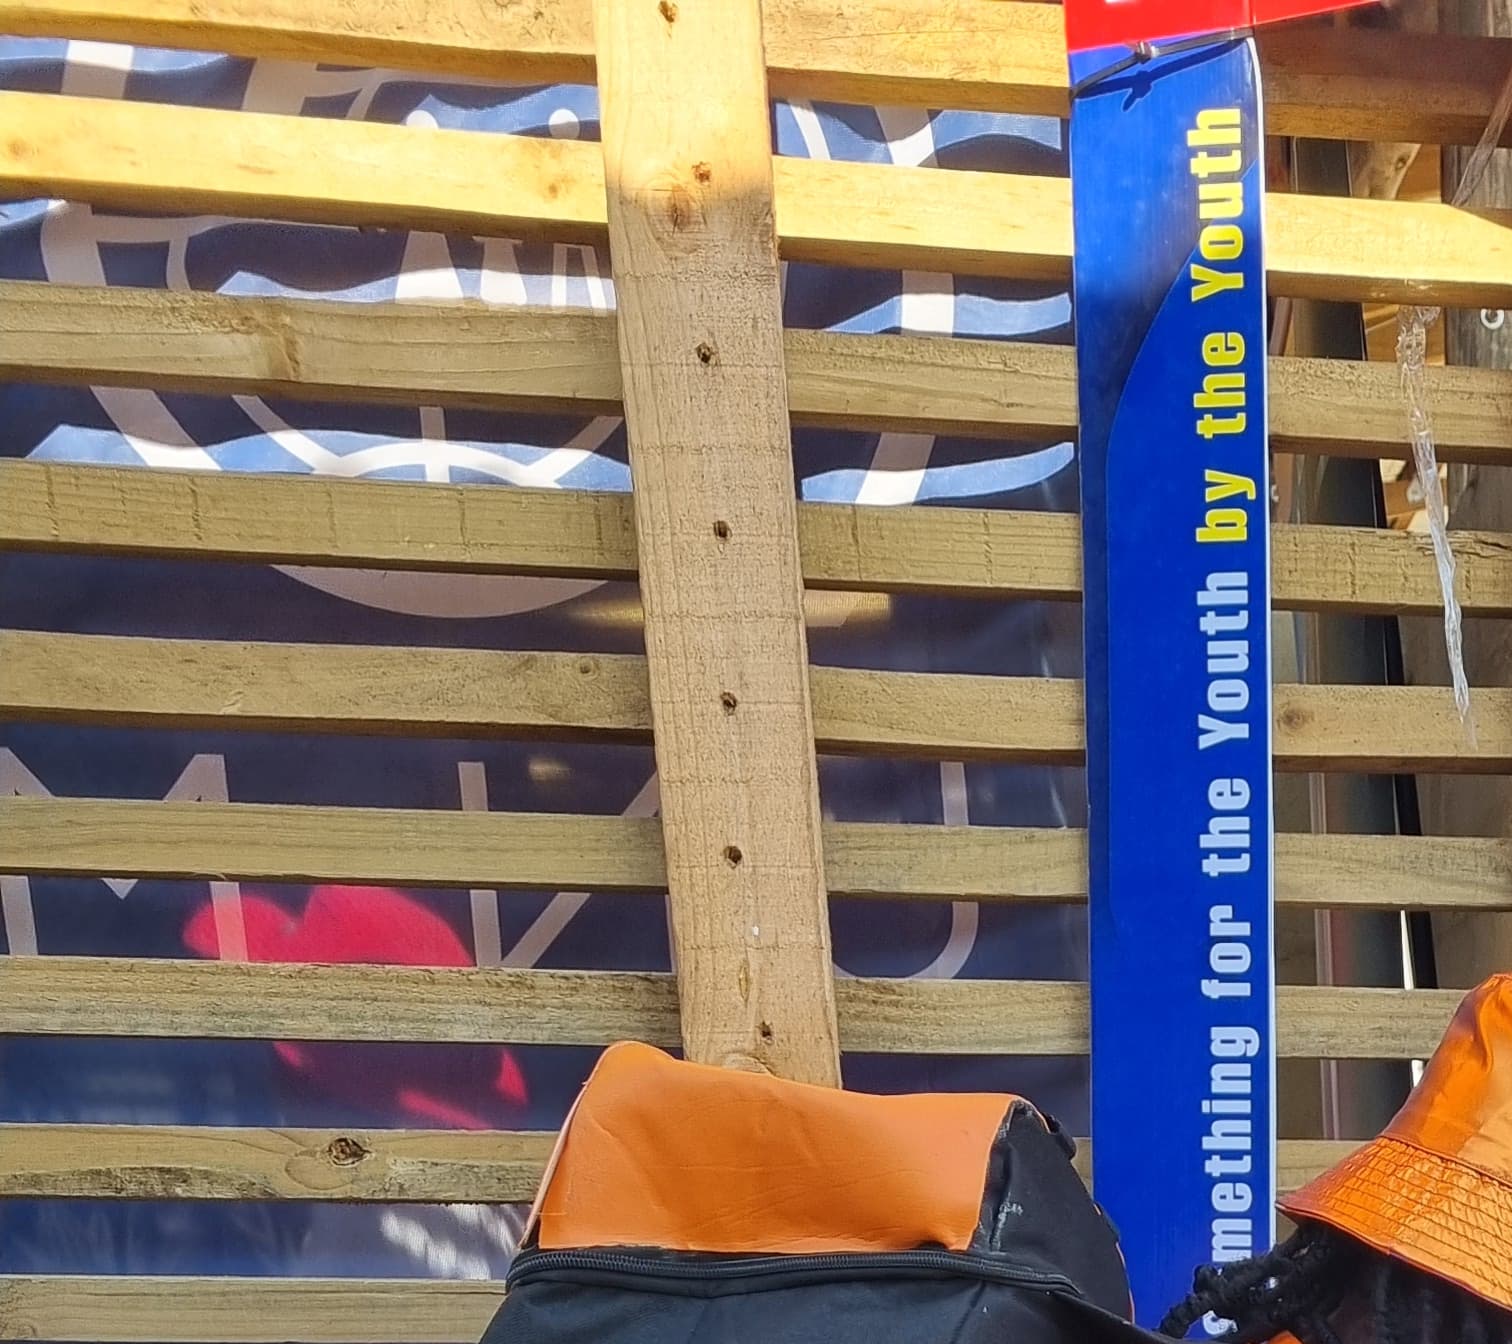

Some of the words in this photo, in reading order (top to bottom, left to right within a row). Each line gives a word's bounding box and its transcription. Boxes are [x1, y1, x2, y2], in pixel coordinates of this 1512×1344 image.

[1187, 107, 1244, 302] Youth
[1194, 332, 1246, 438] the
[1196, 469, 1256, 542] by
[1197, 571, 1250, 749] Youth
[1200, 778, 1251, 877] the
[1201, 905, 1252, 999] for
[1201, 1026, 1260, 1263] mething
